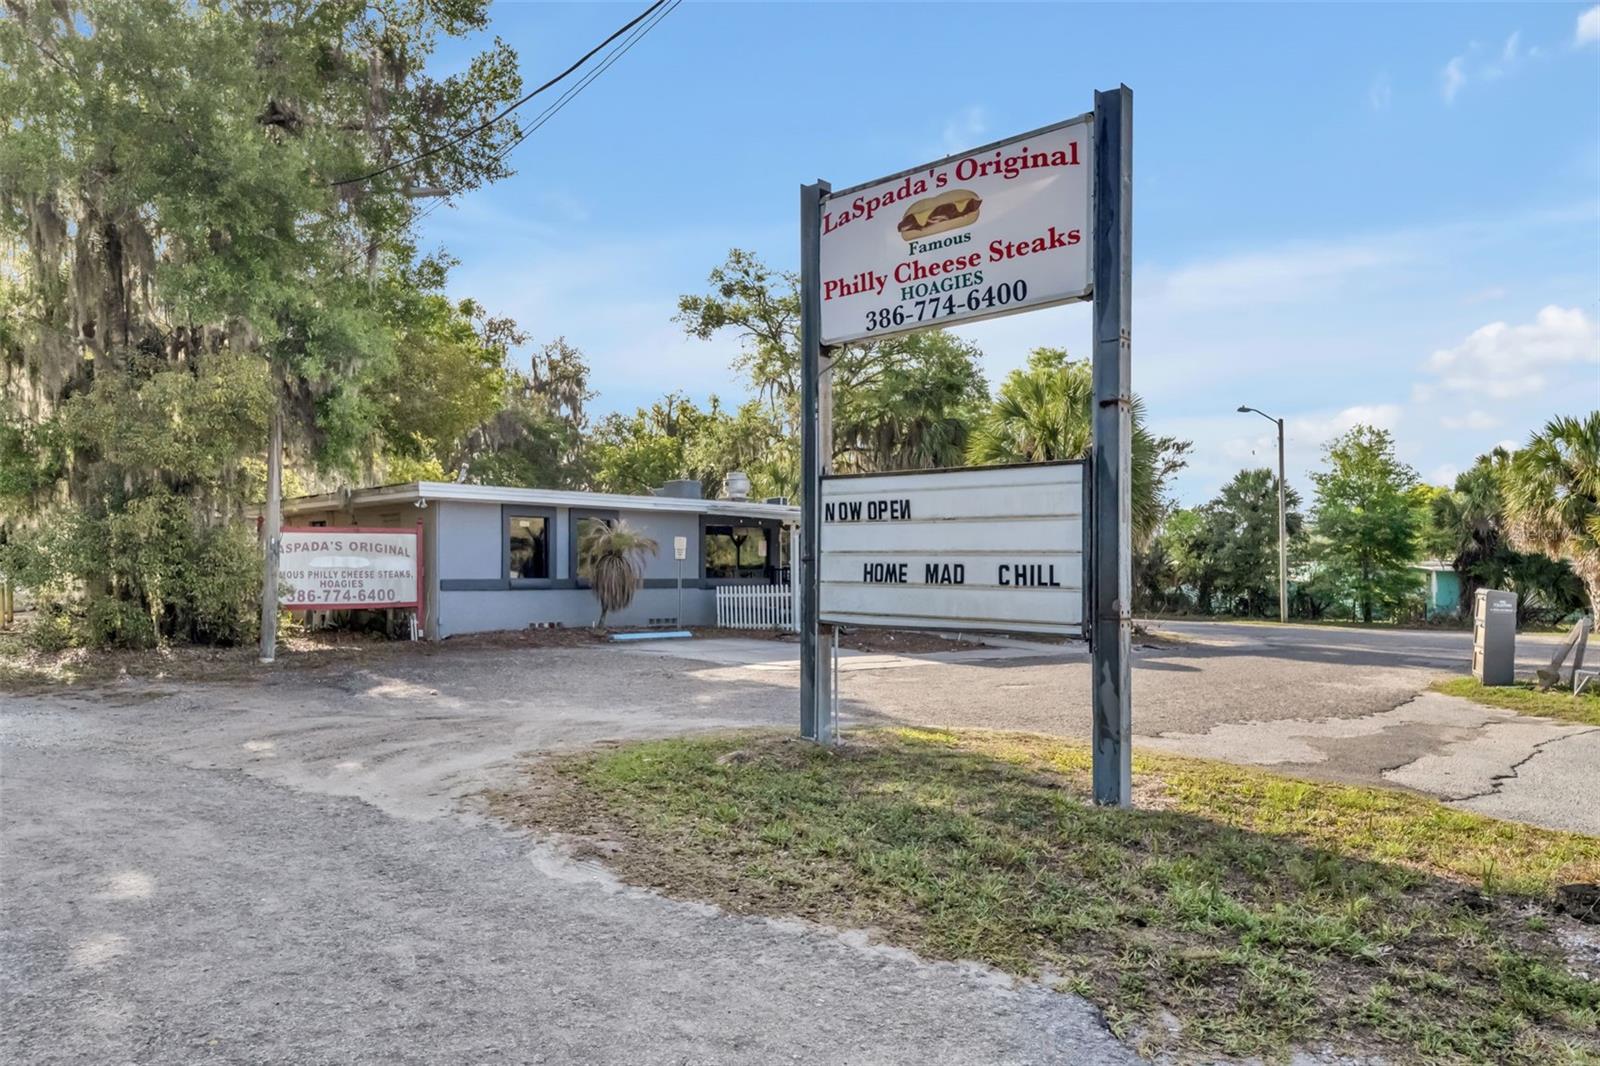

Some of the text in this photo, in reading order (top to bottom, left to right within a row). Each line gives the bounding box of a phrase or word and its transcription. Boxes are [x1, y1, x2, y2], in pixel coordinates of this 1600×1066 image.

[822, 142, 1080, 235] LaSpada's Original
[908, 232, 972, 256] Famous
[823, 226, 1081, 301] Philly Cheese Steaks
[901, 270, 984, 301] HOAGIES
[865, 279, 1028, 331] 386-774-6400
[825, 499, 911, 522] NOW OPEN
[279, 541, 410, 558] ASPADA'S ORIGINAL
[307, 570, 339, 579] PHILLY
[341, 570, 375, 579] CHEESE
[319, 580, 364, 588] HOAGIES
[863, 563, 1061, 587] HOME MAD CHILL
